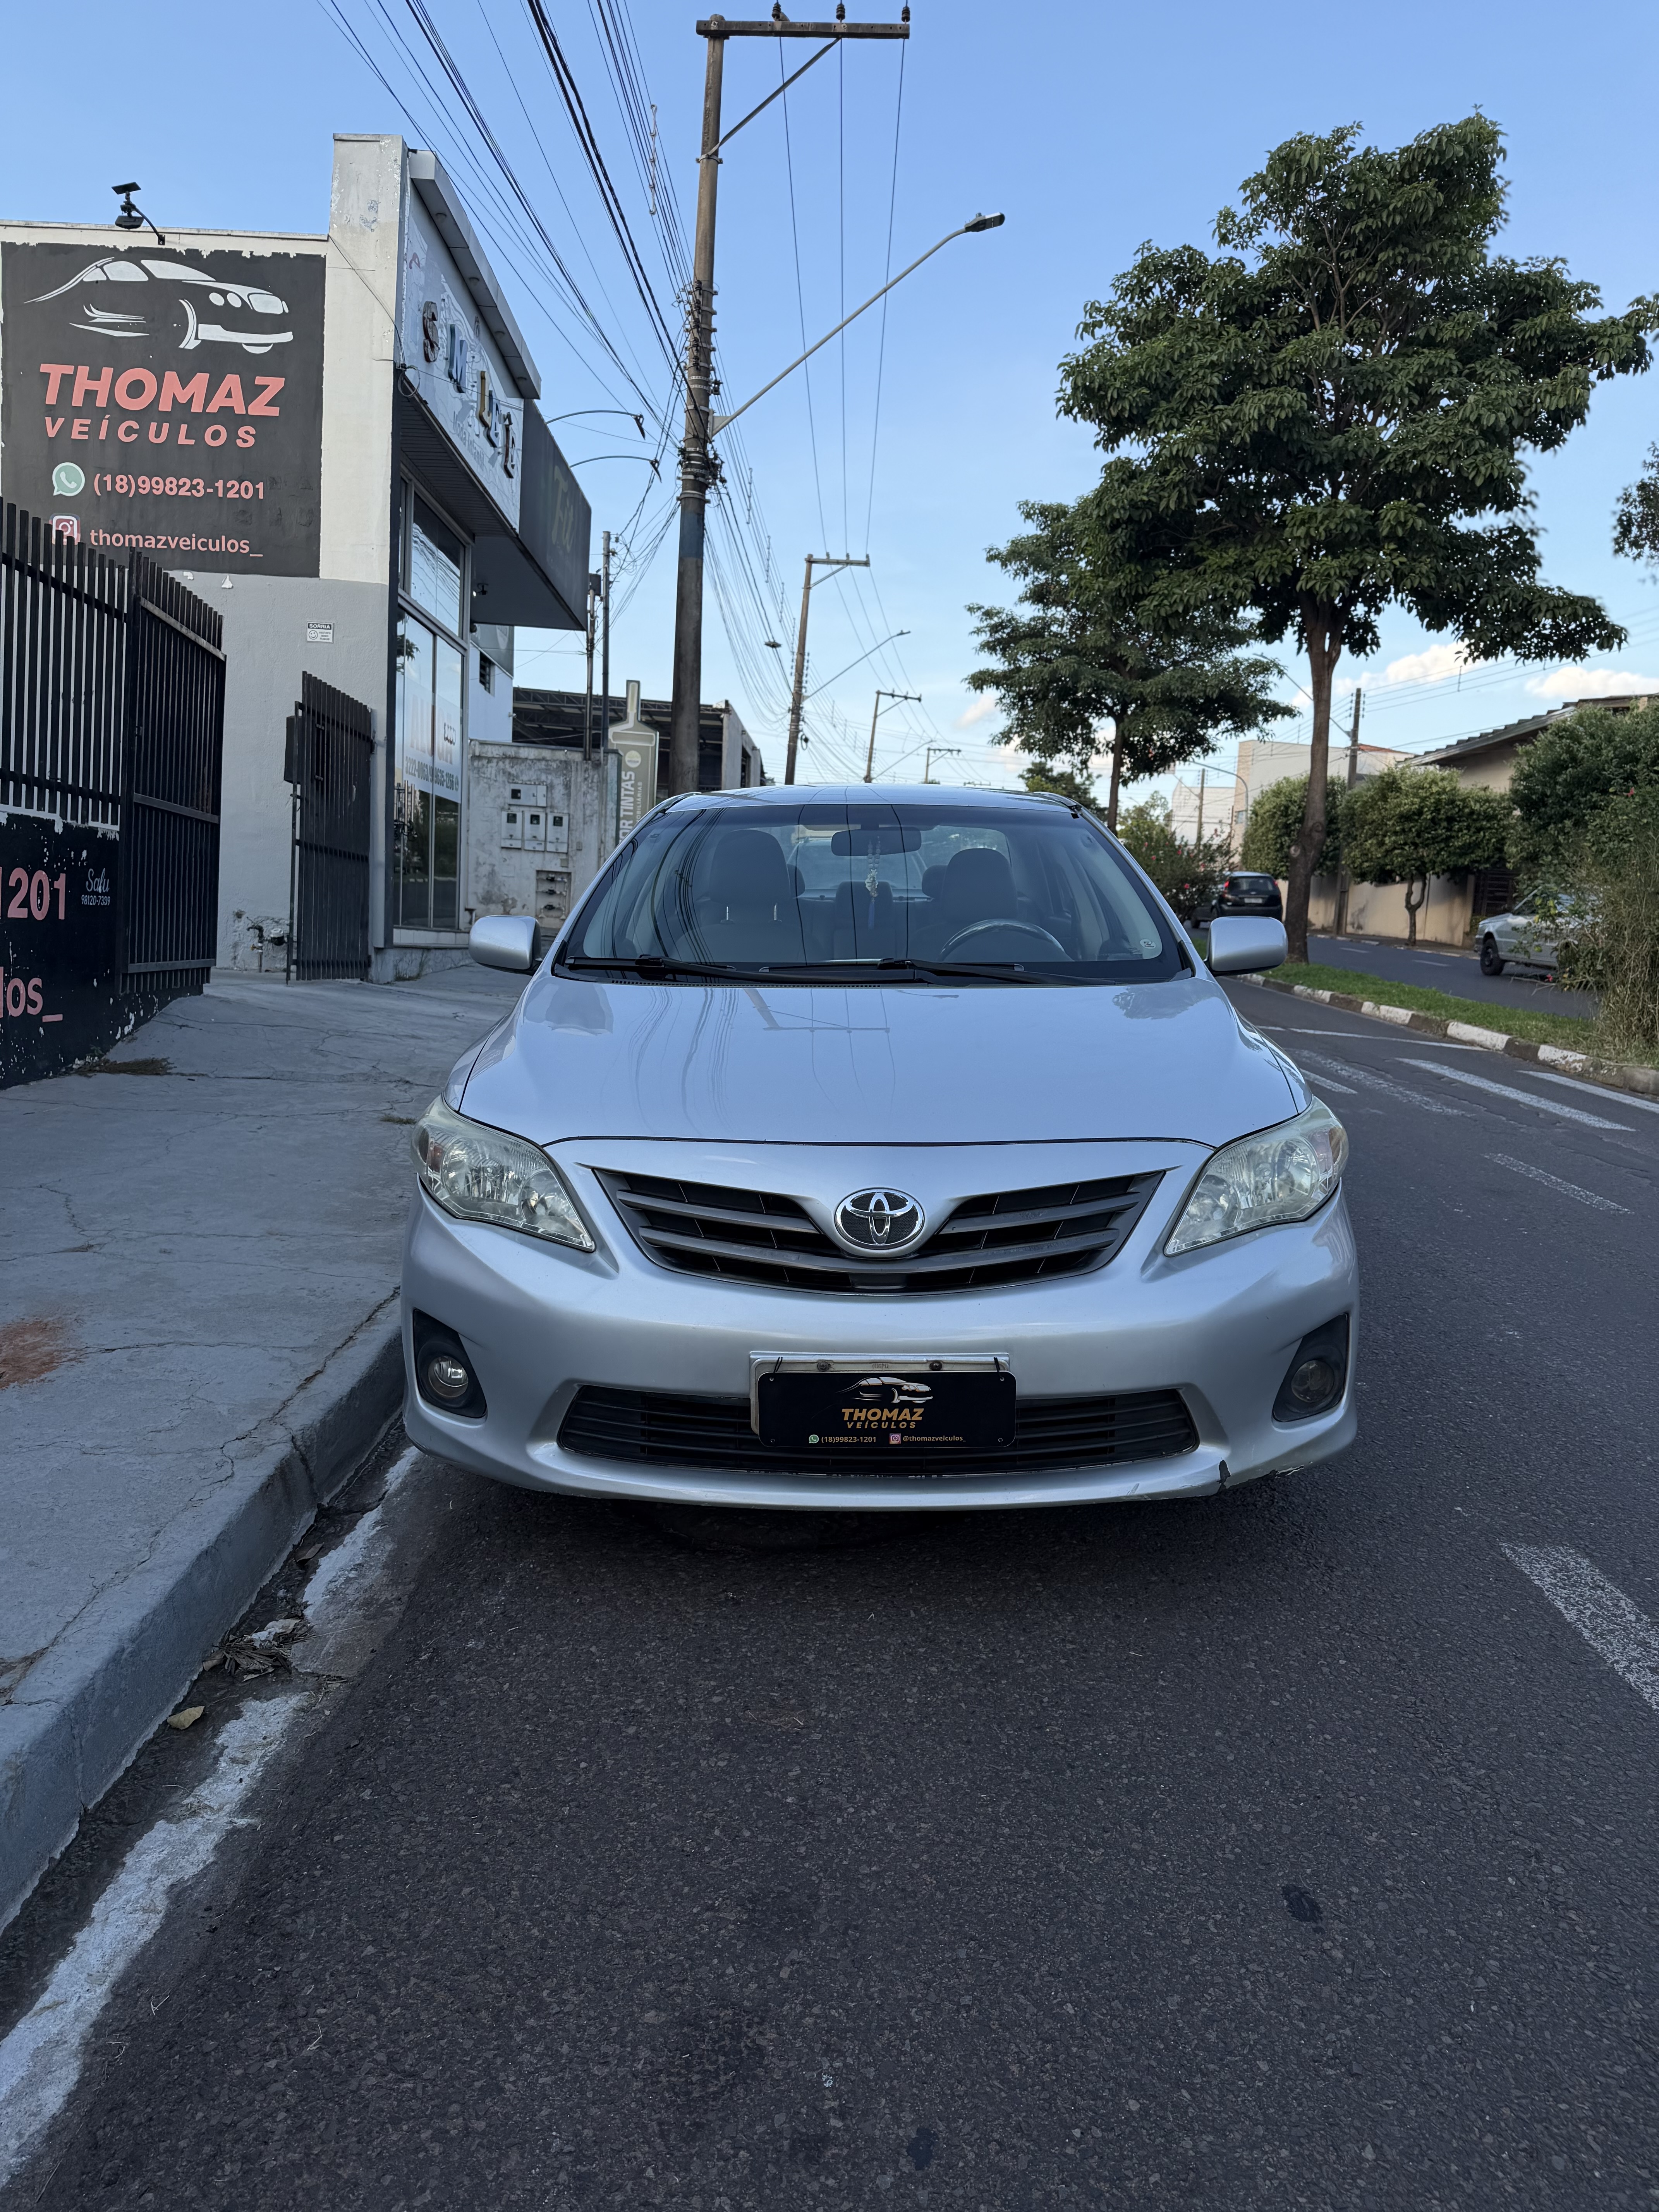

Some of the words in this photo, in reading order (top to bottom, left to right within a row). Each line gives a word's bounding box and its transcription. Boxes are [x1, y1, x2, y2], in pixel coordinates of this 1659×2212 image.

[40, 363, 285, 416] THOMAZ
[45, 415, 256, 448] VEÍCULOS
[94, 474, 264, 499] (18)99823-1201
[90, 529, 263, 557] thomazveiculos_
[620, 771, 635, 817] TINTAS
[619, 820, 633, 843] OR
[842, 1408, 924, 1420] THOMAZ
[847, 1420, 915, 1429] VEÍCULOS
